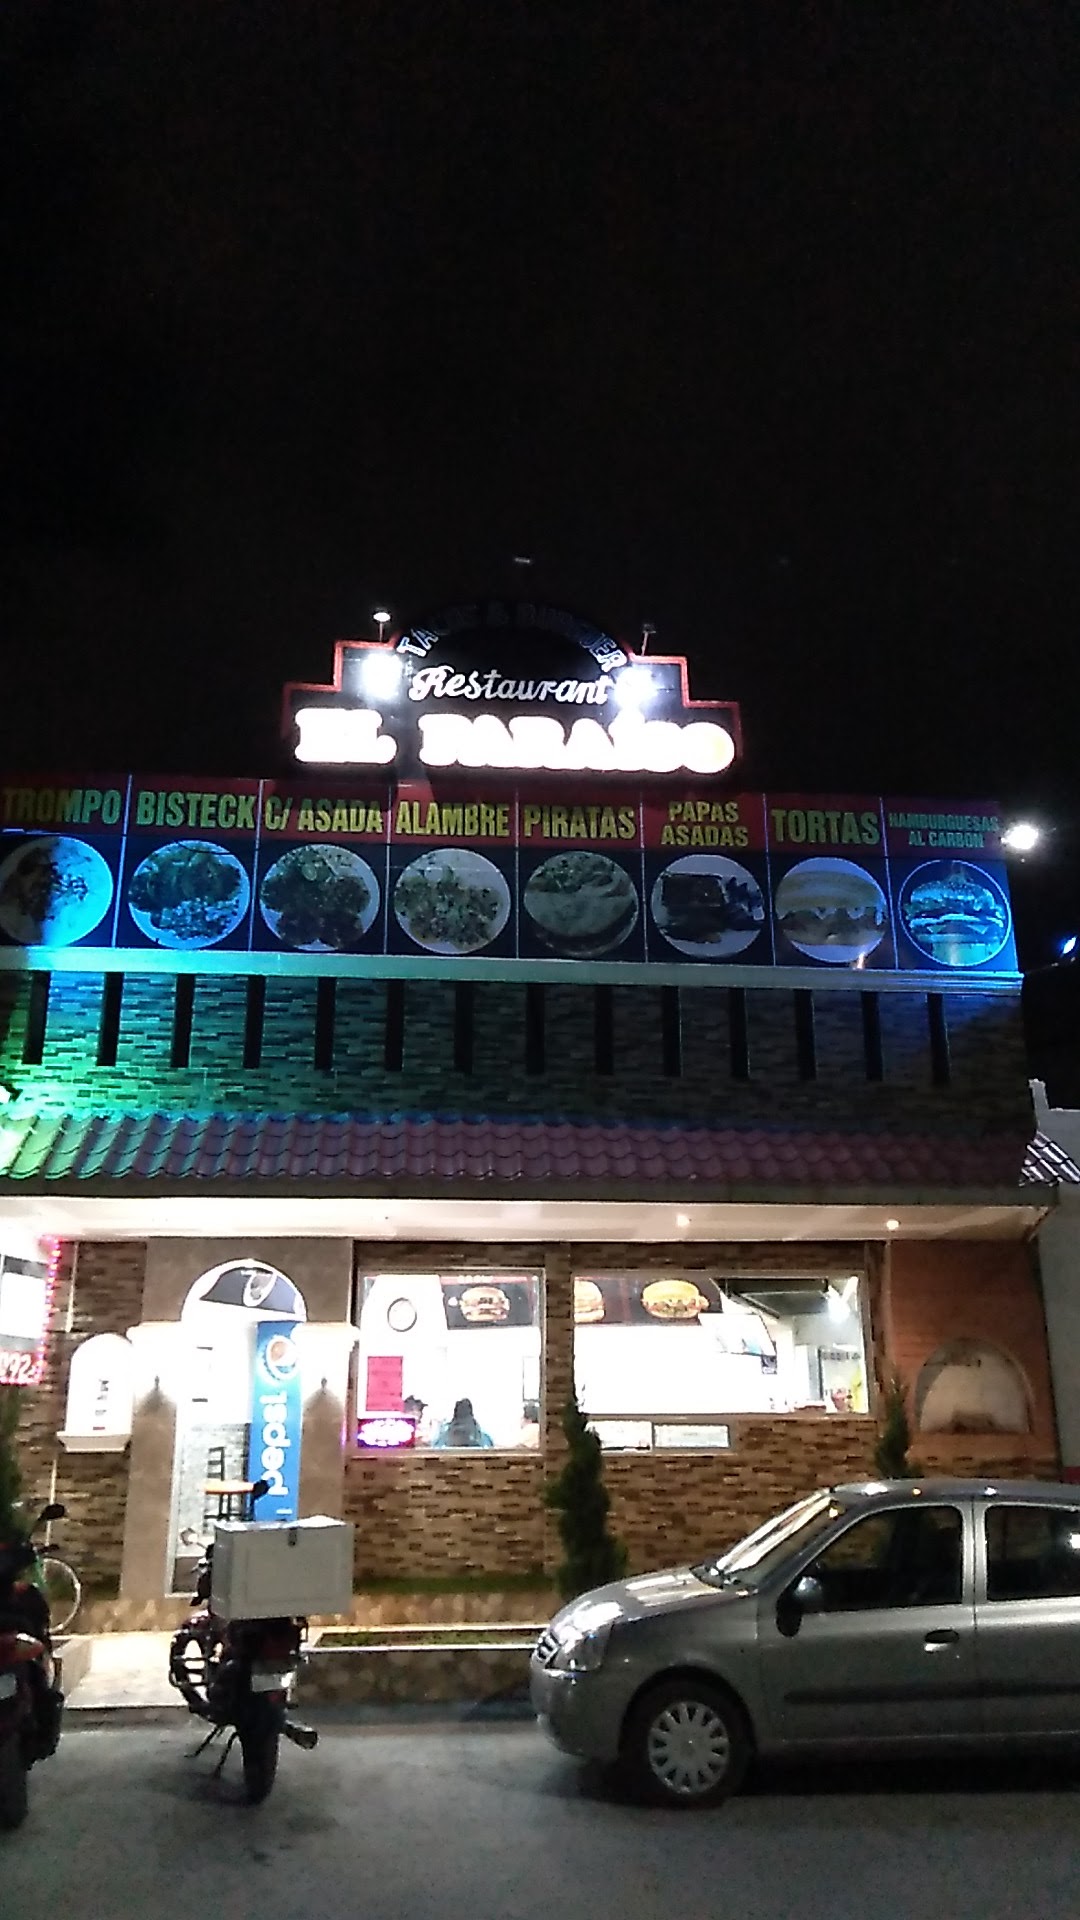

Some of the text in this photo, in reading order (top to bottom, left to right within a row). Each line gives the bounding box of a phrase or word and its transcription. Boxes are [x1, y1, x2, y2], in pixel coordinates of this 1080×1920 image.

[408, 663, 616, 706] Restaurant
[1, 787, 123, 826] TROMPO
[137, 790, 257, 830] BISTECK
[298, 799, 384, 834] ASADA
[395, 801, 510, 838] ALAMBRE
[523, 803, 637, 841] PIRATAS
[667, 800, 740, 824] PAPAS
[888, 812, 1000, 832] HAMBURGUESAS
[660, 824, 749, 848] ASADAS
[771, 808, 881, 846] TORTAS
[908, 831, 926, 847] AL
[259, 1389, 292, 1496] pepsi
